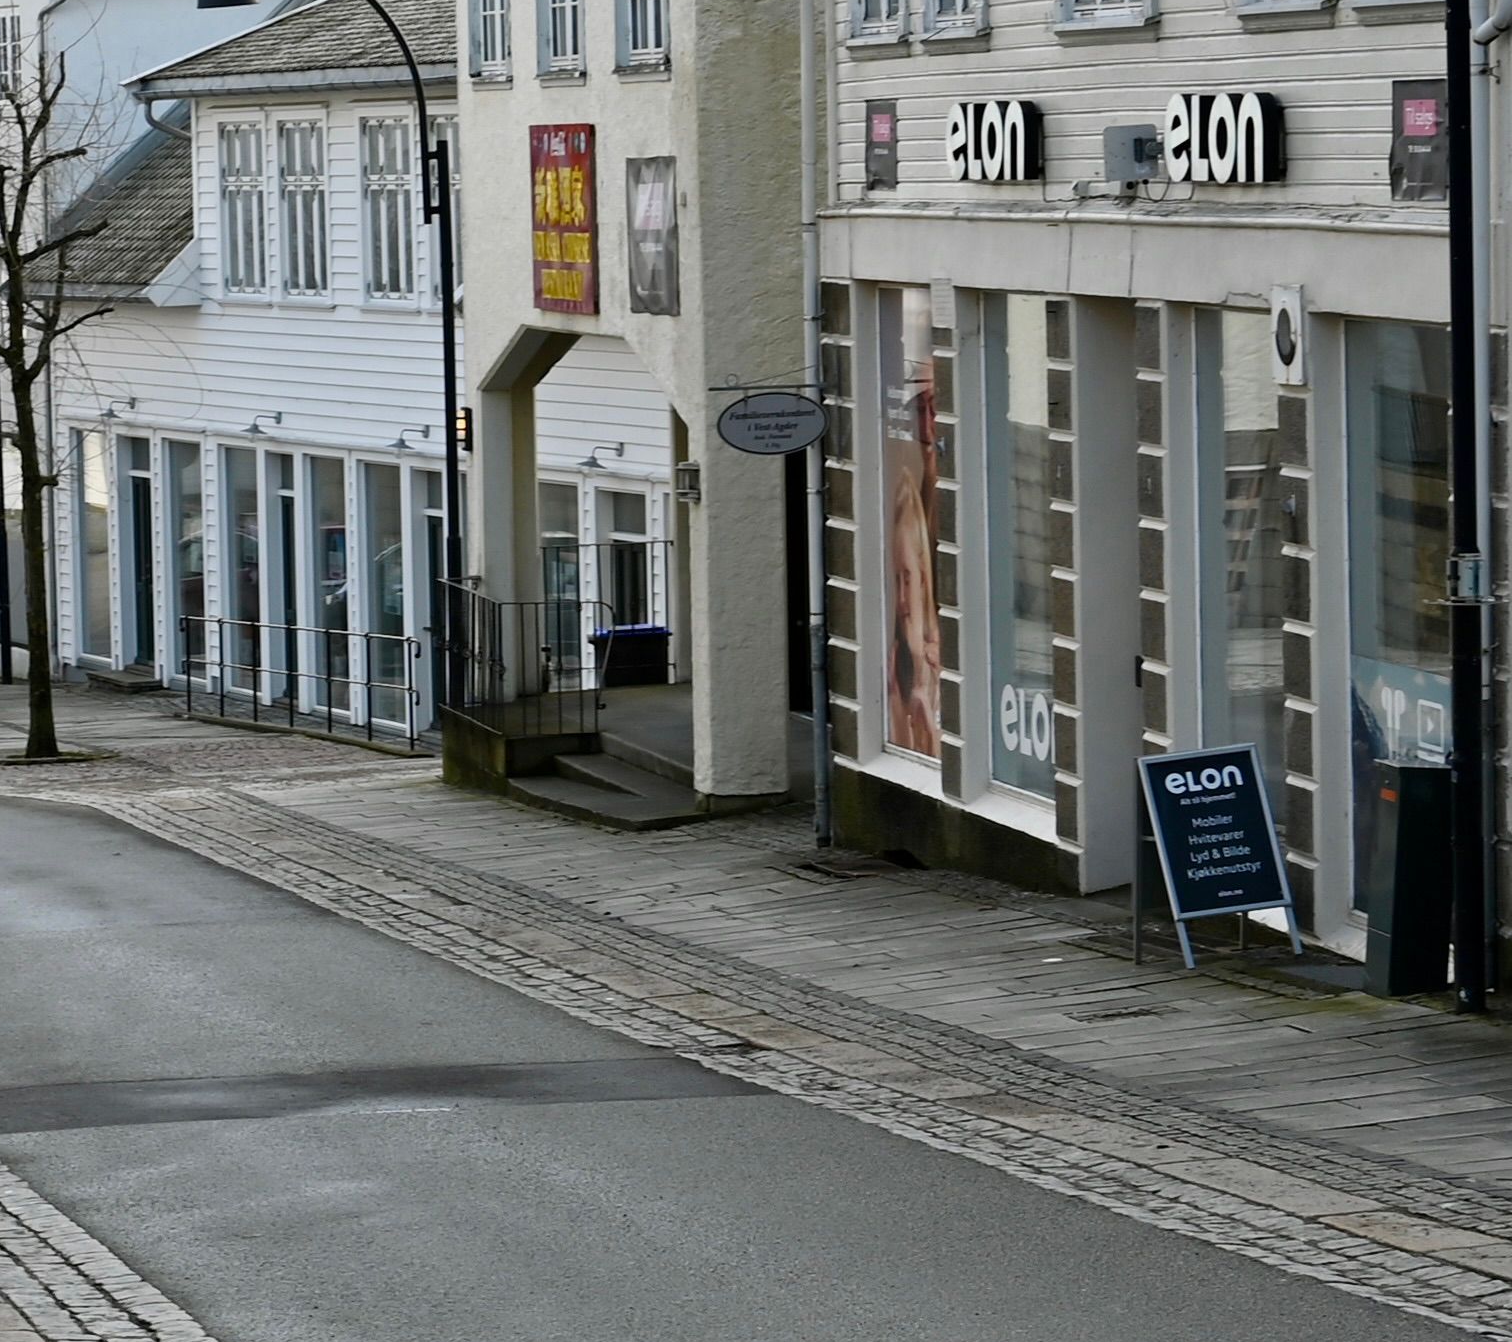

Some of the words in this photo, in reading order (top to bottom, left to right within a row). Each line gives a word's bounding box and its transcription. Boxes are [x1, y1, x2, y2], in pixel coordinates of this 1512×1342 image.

[1191, 814, 1233, 828] Mobiler
[1188, 830, 1245, 845] Hvitevarer
[1190, 851, 1210, 864] Lyd
[1211, 849, 1221, 858] &
[1223, 845, 1251, 857] Bilde
[1186, 861, 1262, 881] Kjøkkenutstyr
